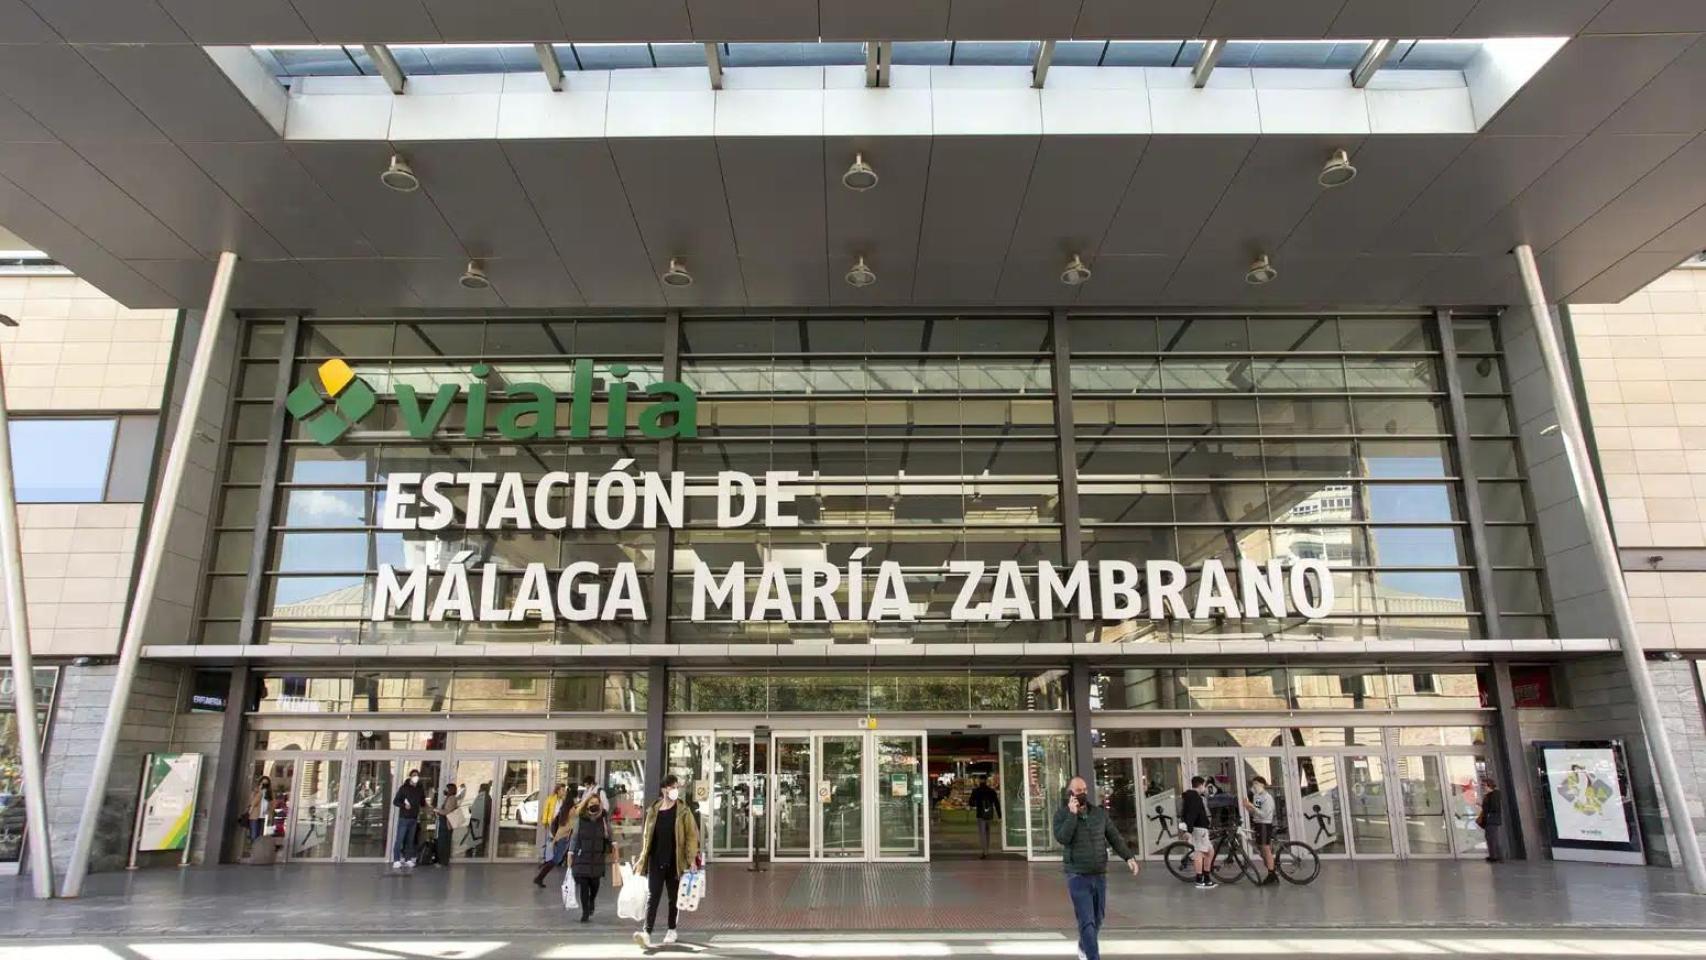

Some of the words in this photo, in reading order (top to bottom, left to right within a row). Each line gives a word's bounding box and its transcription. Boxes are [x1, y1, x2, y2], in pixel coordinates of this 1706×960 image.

[393, 358, 699, 439] vialia
[382, 458, 686, 531] ESTACIÓN
[716, 470, 800, 528] DE
[371, 551, 648, 623] MÁLAGA
[691, 546, 915, 622] MARÍA
[950, 557, 1336, 621] ZAMBRANO
